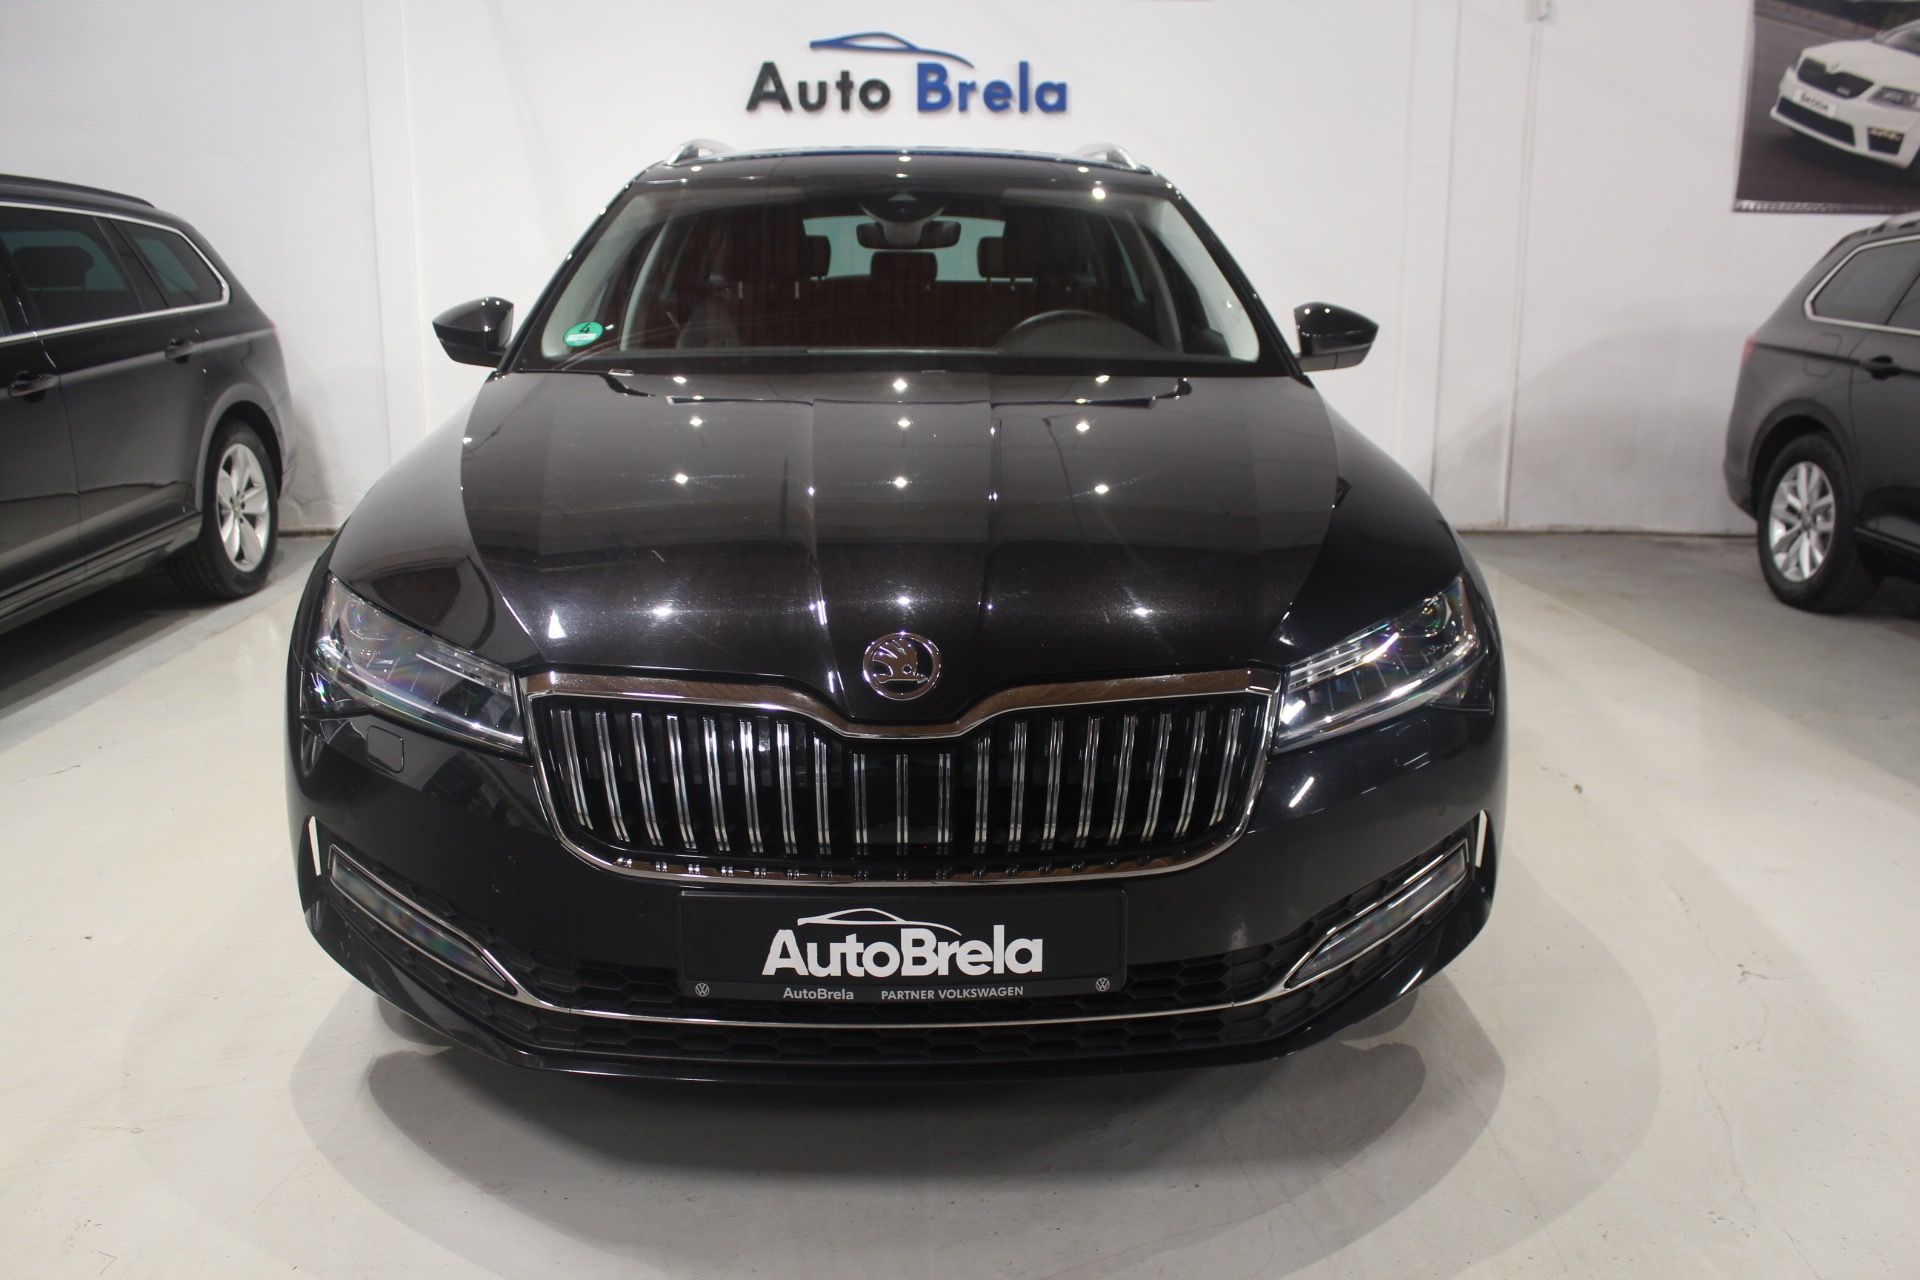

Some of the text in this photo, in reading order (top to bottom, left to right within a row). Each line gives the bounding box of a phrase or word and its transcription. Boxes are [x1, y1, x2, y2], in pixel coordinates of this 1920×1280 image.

[745, 60, 1068, 113] Auto Brela
[762, 924, 1043, 978] AutoBrela
[783, 986, 1024, 1000] AutoBrela PARTNER VOLKSWAGEN
